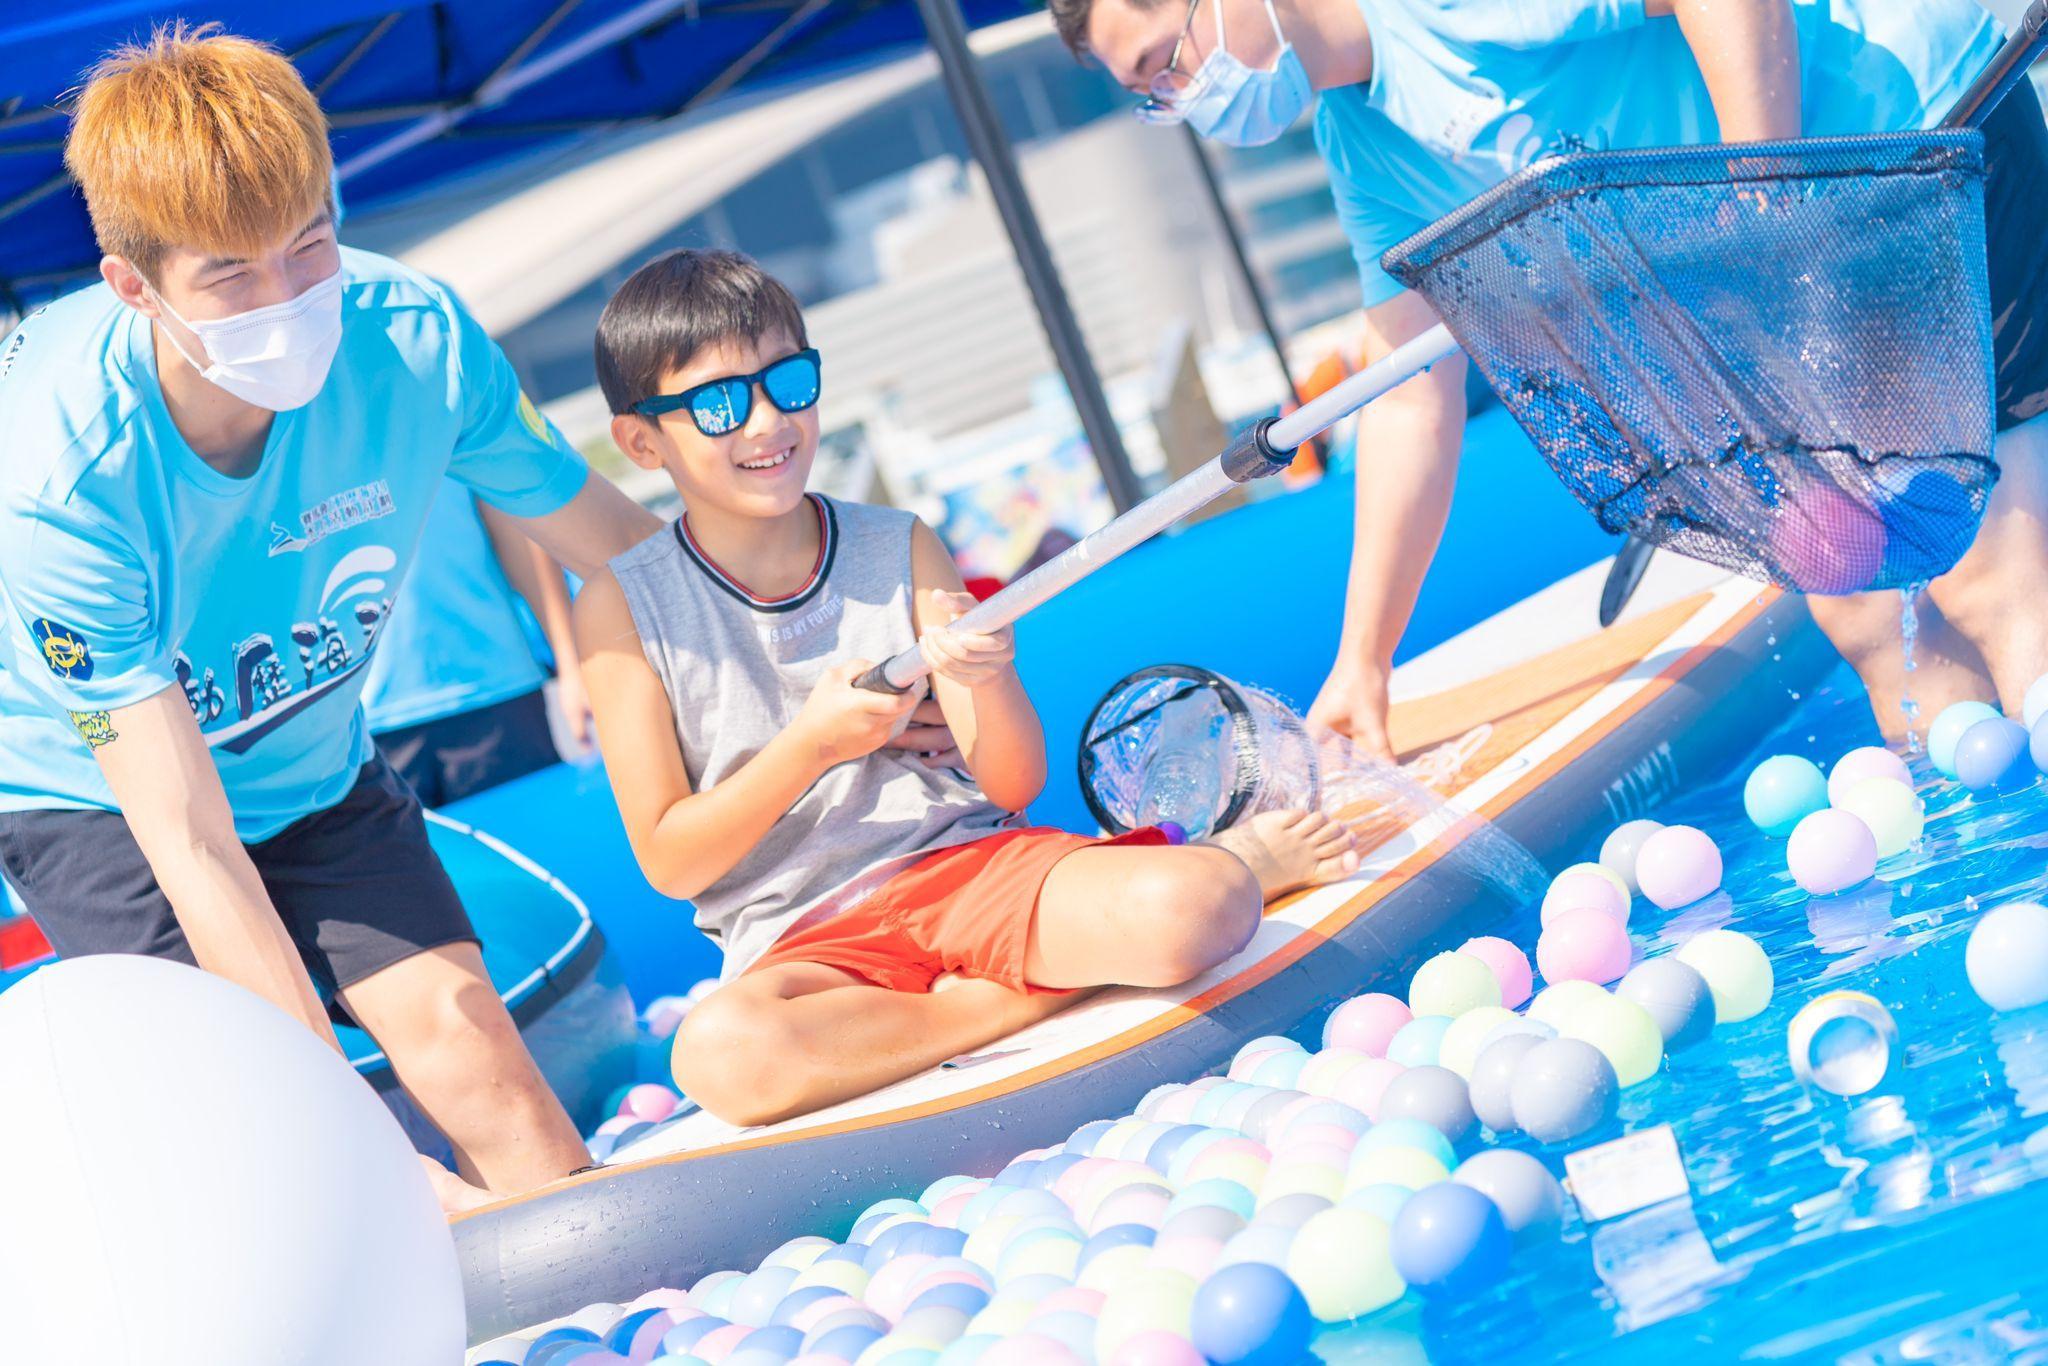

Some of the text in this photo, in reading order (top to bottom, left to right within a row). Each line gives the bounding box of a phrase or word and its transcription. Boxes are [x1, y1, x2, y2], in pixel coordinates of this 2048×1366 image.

[756, 594, 844, 642] TIS IS MY FUTURE
